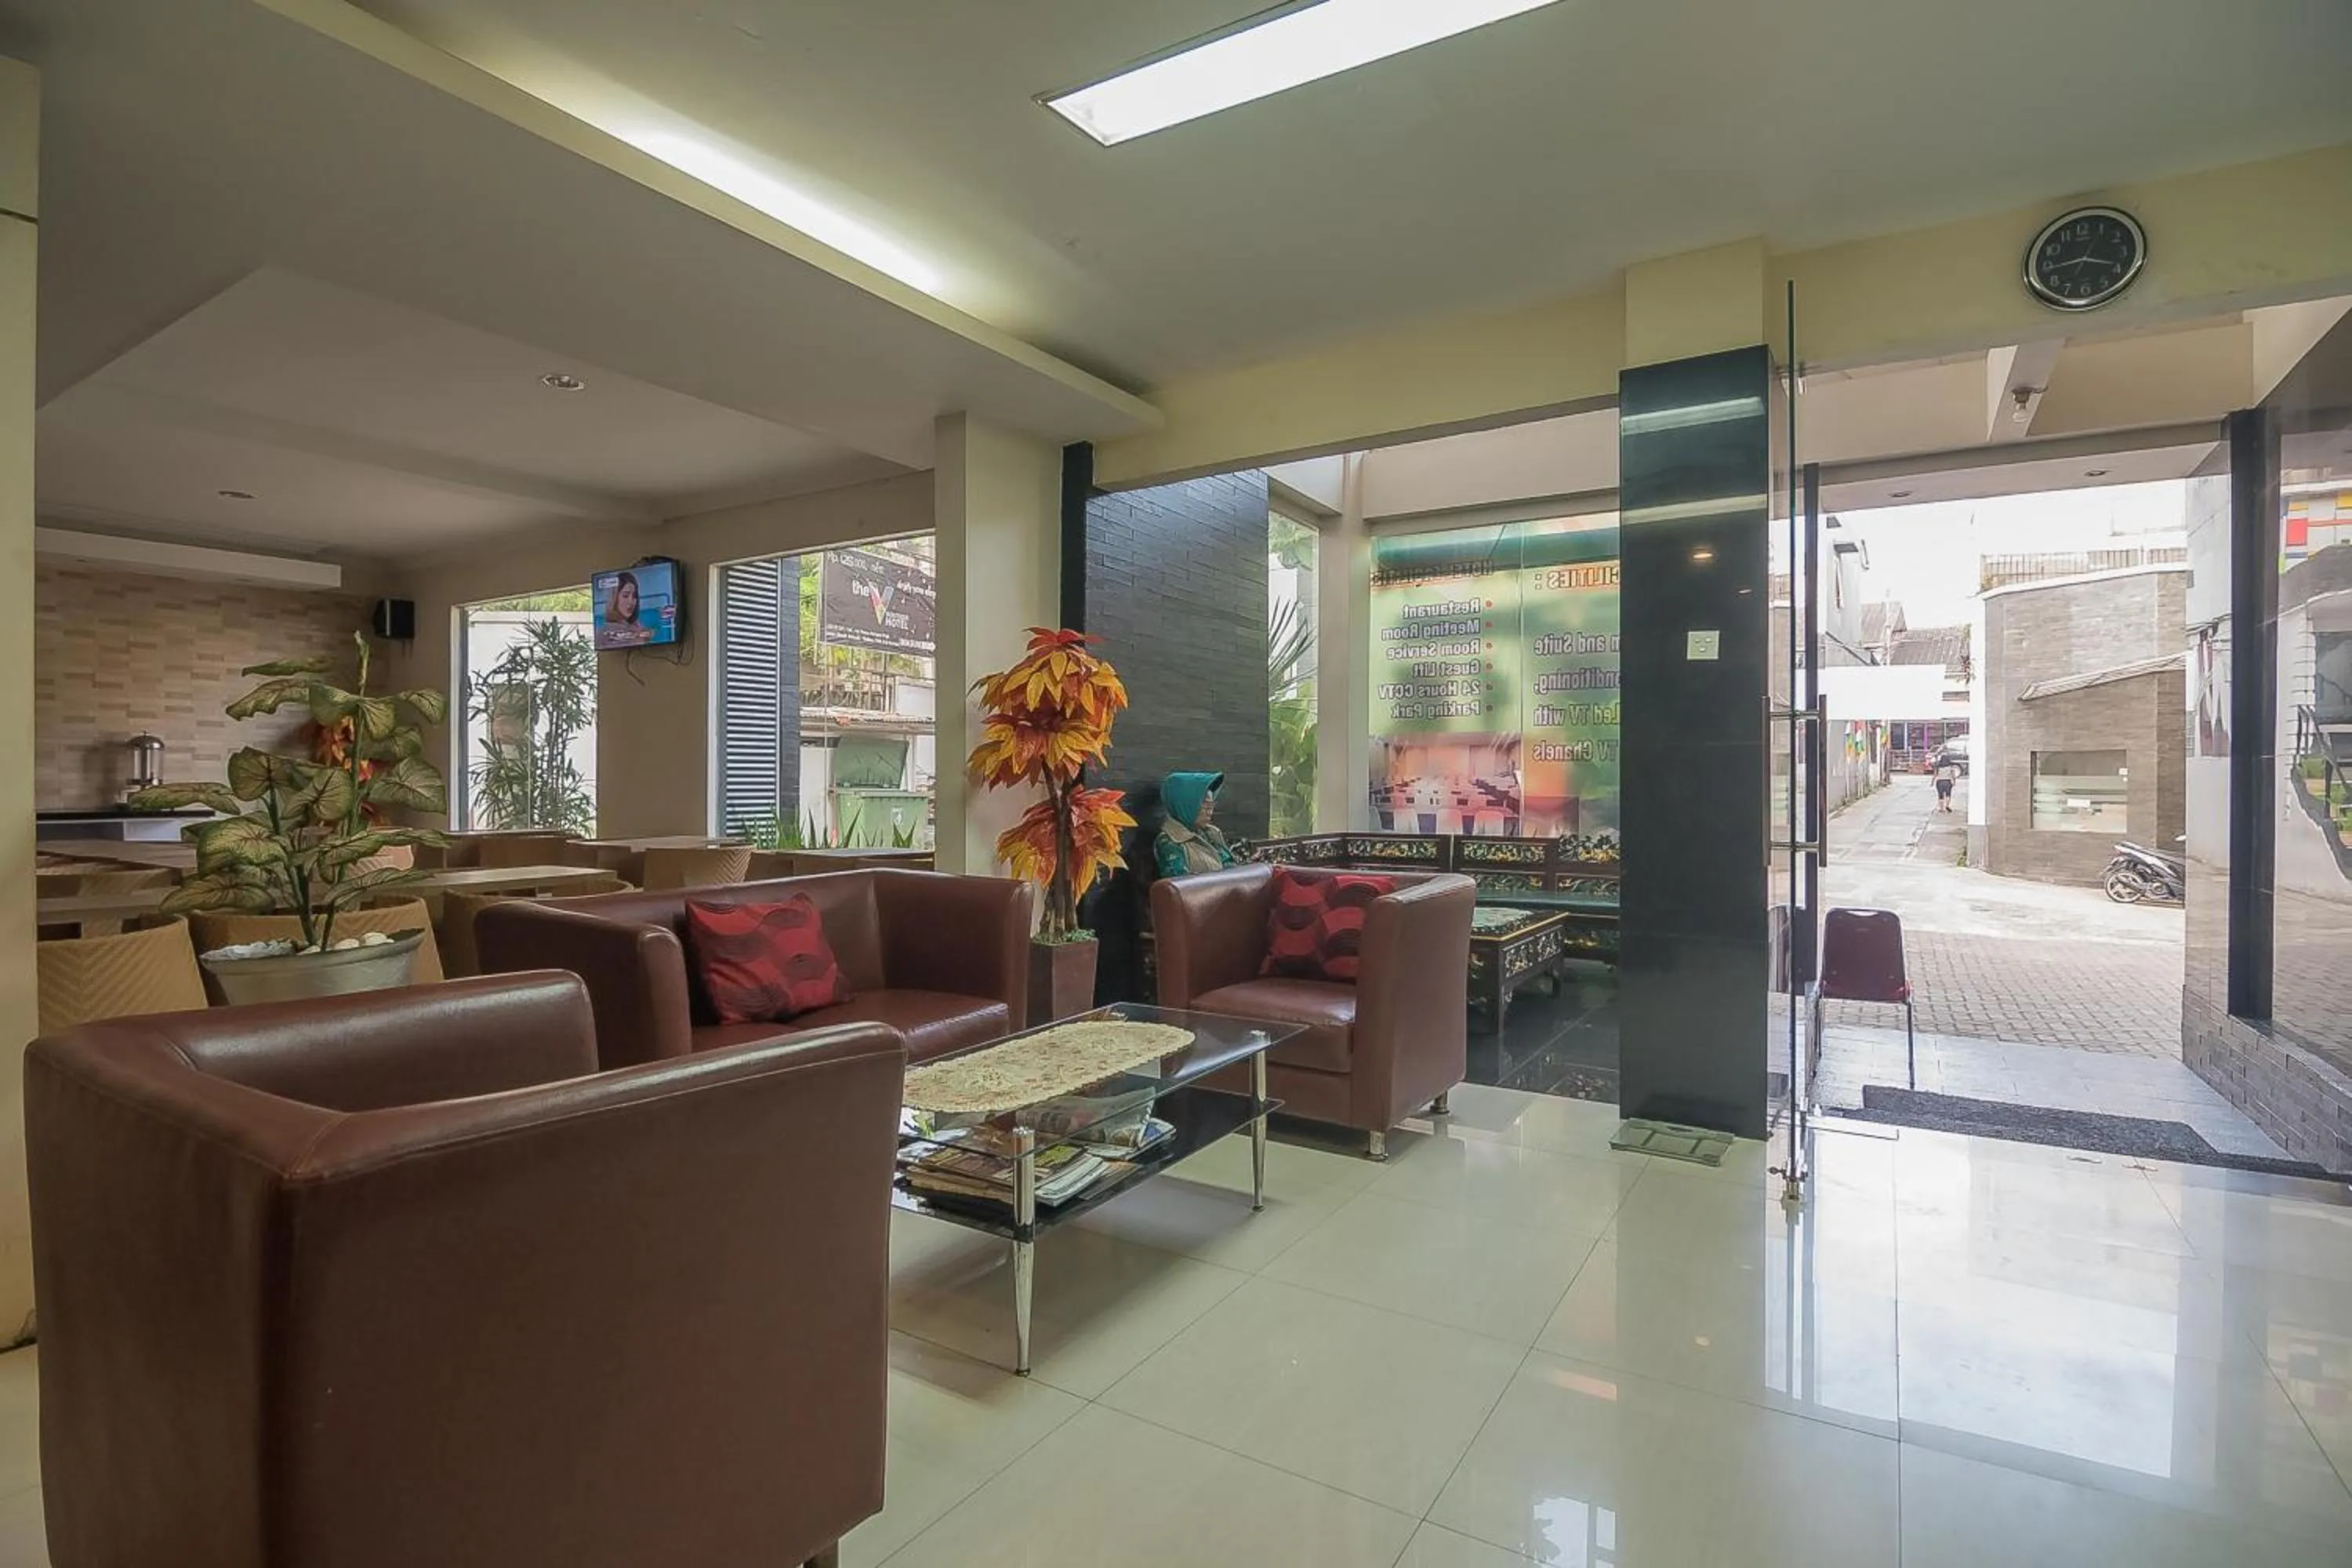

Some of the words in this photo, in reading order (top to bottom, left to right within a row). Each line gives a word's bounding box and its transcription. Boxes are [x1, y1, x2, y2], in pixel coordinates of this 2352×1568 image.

[2077, 223, 2089, 236] 12
[2061, 230, 2071, 244] 11
[2046, 244, 2061, 256] 10
[2063, 283, 2071, 296] 7
[2080, 282, 2091, 296] 6
[852, 579, 869, 597] the
